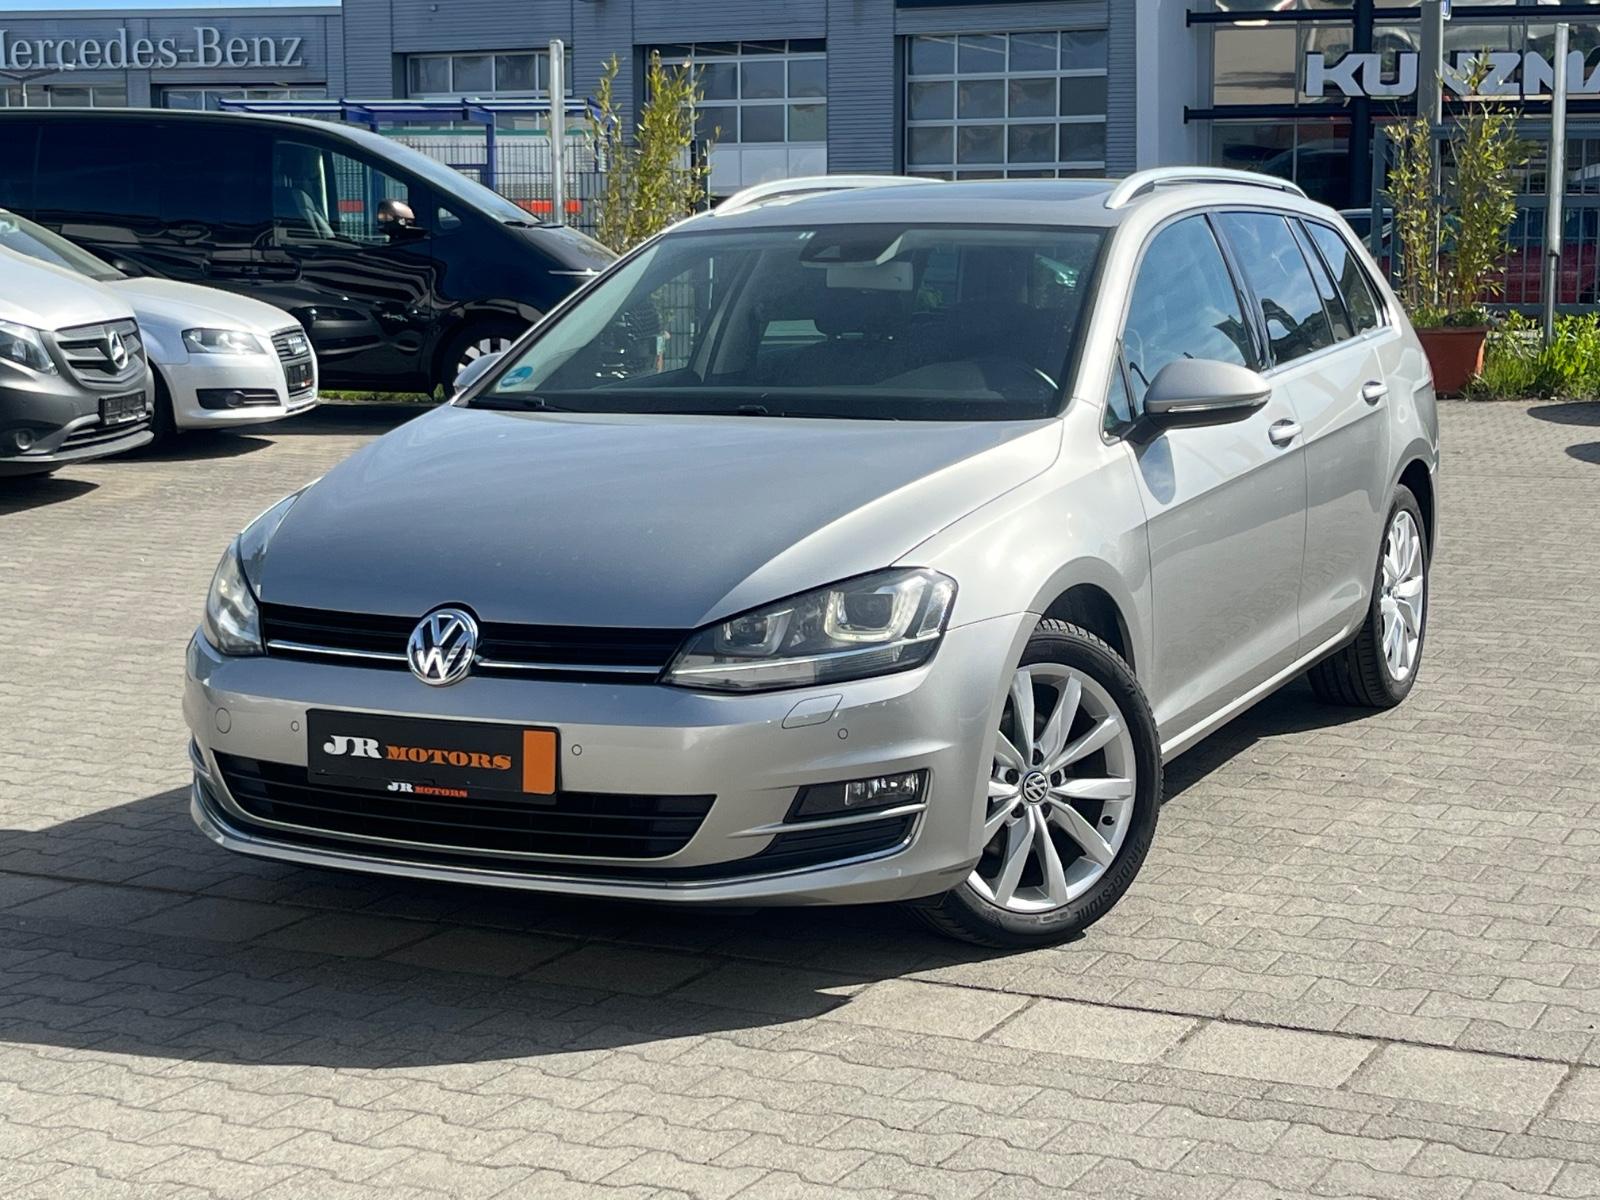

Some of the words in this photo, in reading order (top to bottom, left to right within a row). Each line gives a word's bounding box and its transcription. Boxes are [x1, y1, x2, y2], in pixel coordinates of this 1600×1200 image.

[0, 26, 303, 69] ercedes-Benz
[407, 608, 478, 687] VW
[323, 735, 383, 759] JR
[385, 745, 512, 770] MOTORS
[387, 781, 414, 793] JR
[415, 785, 468, 798] MOTORS
